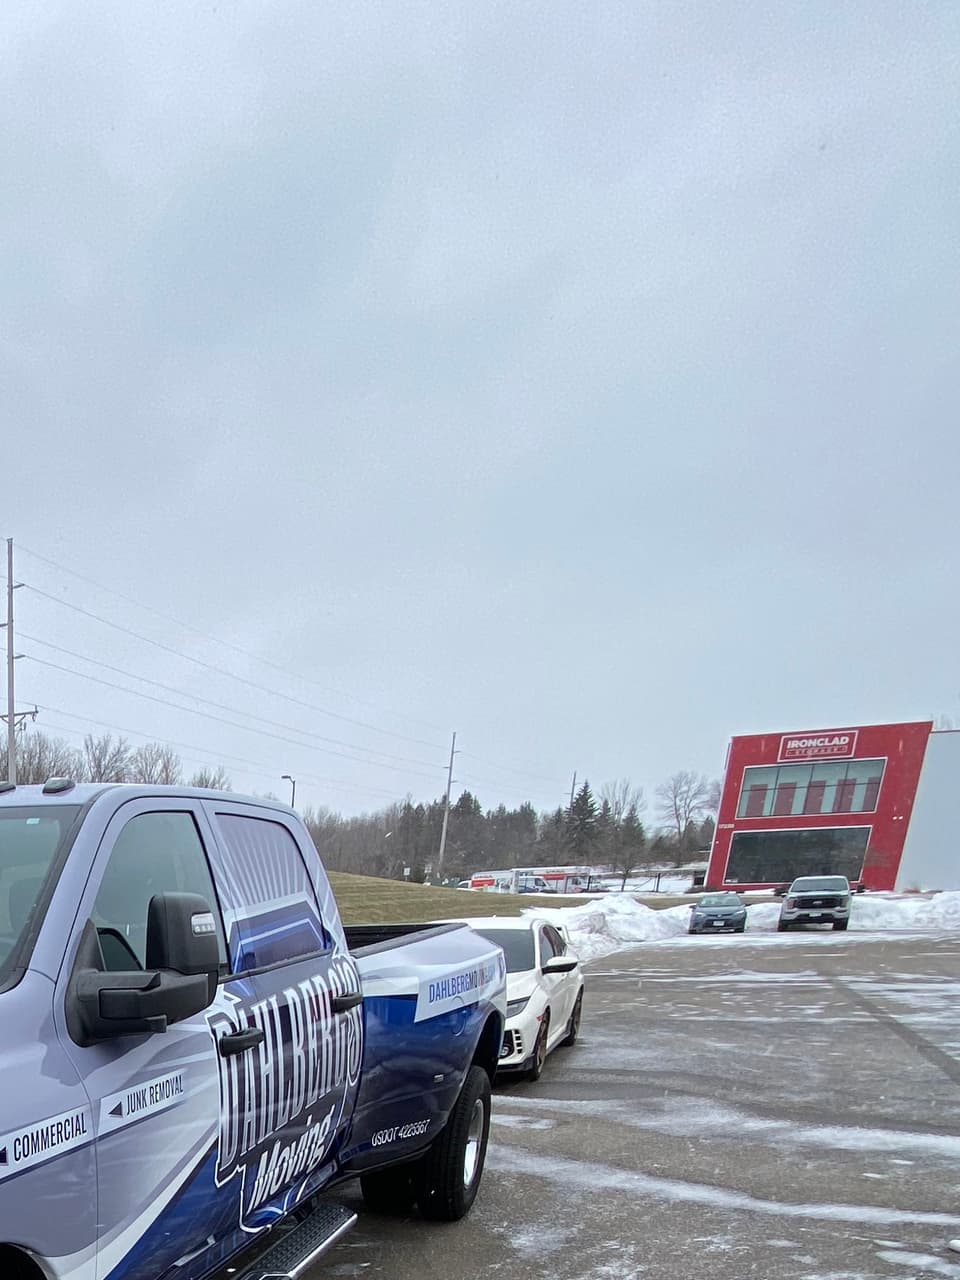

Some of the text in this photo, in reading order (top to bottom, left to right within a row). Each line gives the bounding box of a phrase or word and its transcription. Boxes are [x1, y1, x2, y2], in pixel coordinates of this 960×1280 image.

[787, 736, 849, 748] IRONCLAD
[126, 1075, 183, 1116] JUNK REMOVAL
[13, 1112, 87, 1161] COMMERCIAL
[371, 1126, 400, 1146] USDOT
[246, 1103, 335, 1215] Moving
